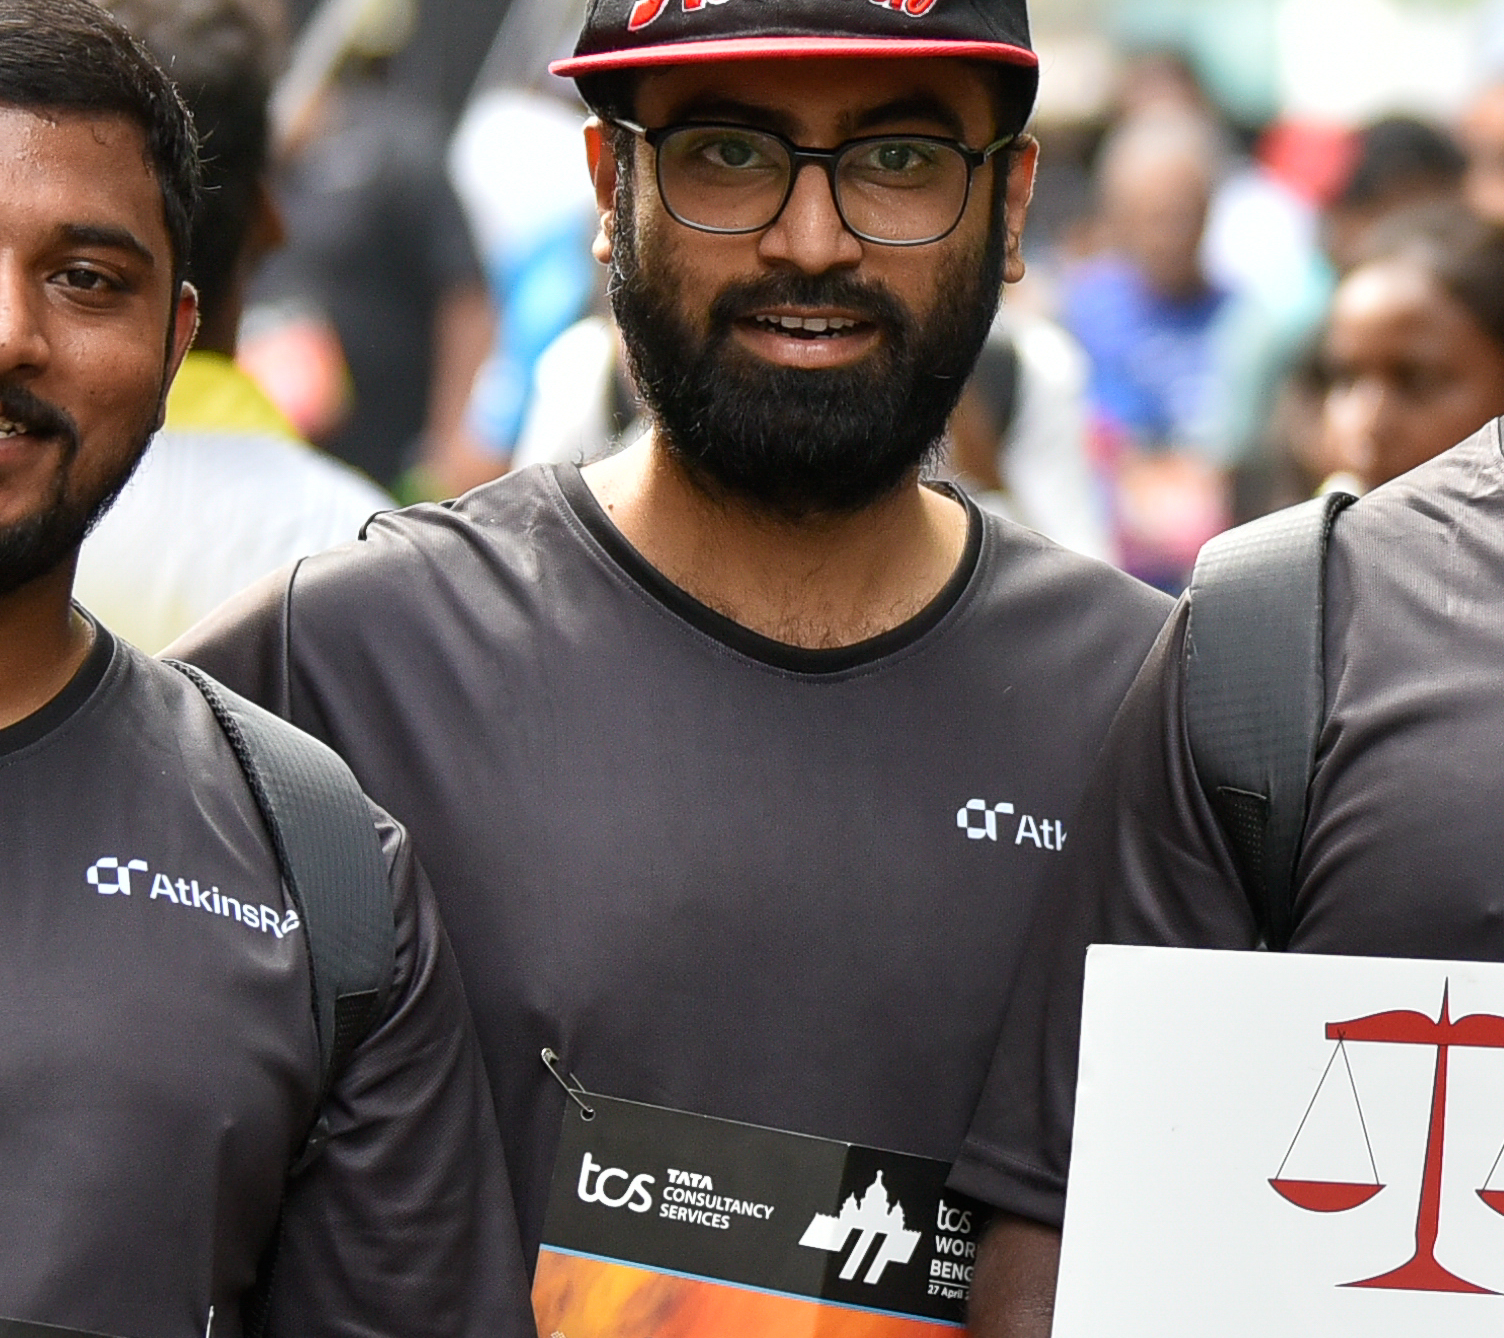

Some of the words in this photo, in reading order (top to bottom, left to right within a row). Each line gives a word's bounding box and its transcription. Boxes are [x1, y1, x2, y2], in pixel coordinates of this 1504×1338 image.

[577, 1151, 652, 1214] tcs
[667, 1168, 713, 1191] TATA
[659, 1203, 730, 1230] SERVICES
[663, 1185, 775, 1221] CONSULTANCY
[937, 1199, 972, 1234] tcs
[935, 1235, 979, 1258] WOR
[927, 1285, 939, 1295] 27
[941, 1287, 963, 1299] April
